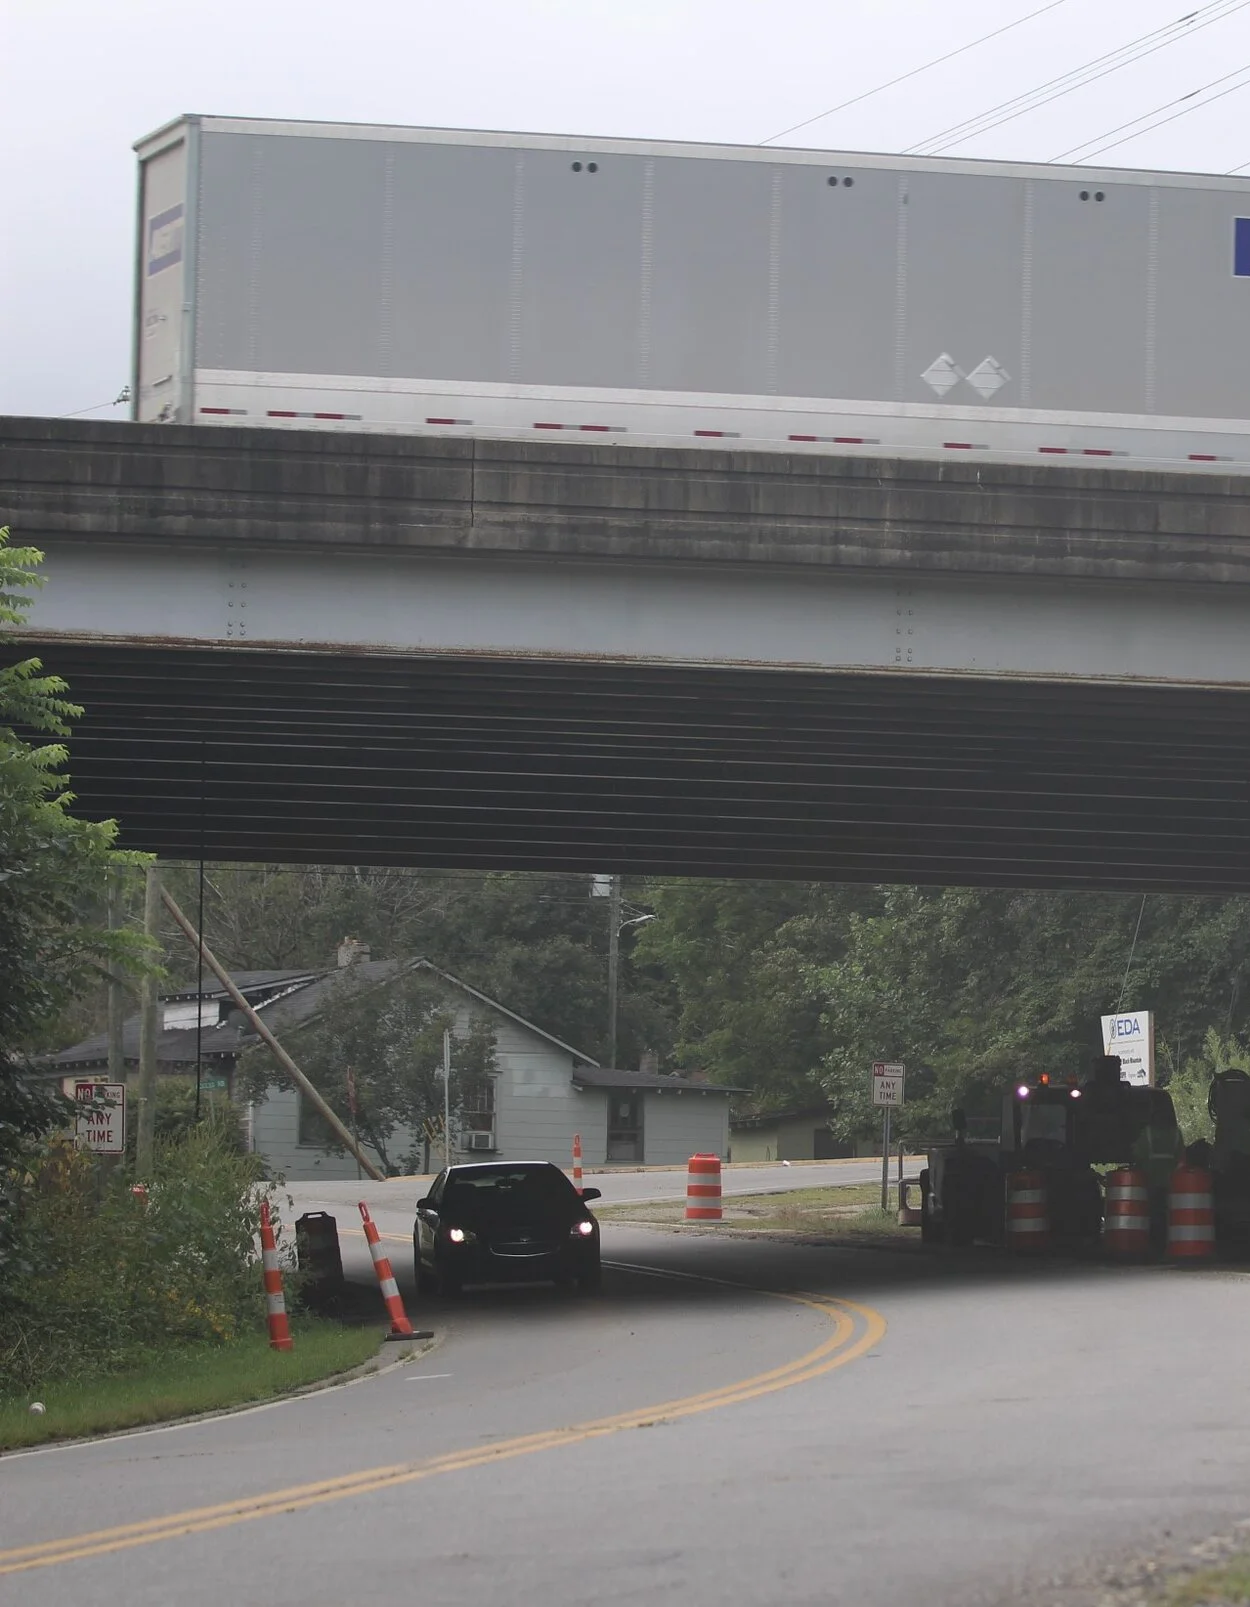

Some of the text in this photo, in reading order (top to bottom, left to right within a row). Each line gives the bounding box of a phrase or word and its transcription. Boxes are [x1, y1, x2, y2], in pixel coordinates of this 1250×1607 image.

[1117, 1018, 1141, 1036] EDA
[875, 1064, 884, 1075] NO
[880, 1080, 896, 1089] ANY
[879, 1092, 897, 1101] TIME
[87, 1111, 112, 1125] ANY
[86, 1129, 113, 1143] TIME
